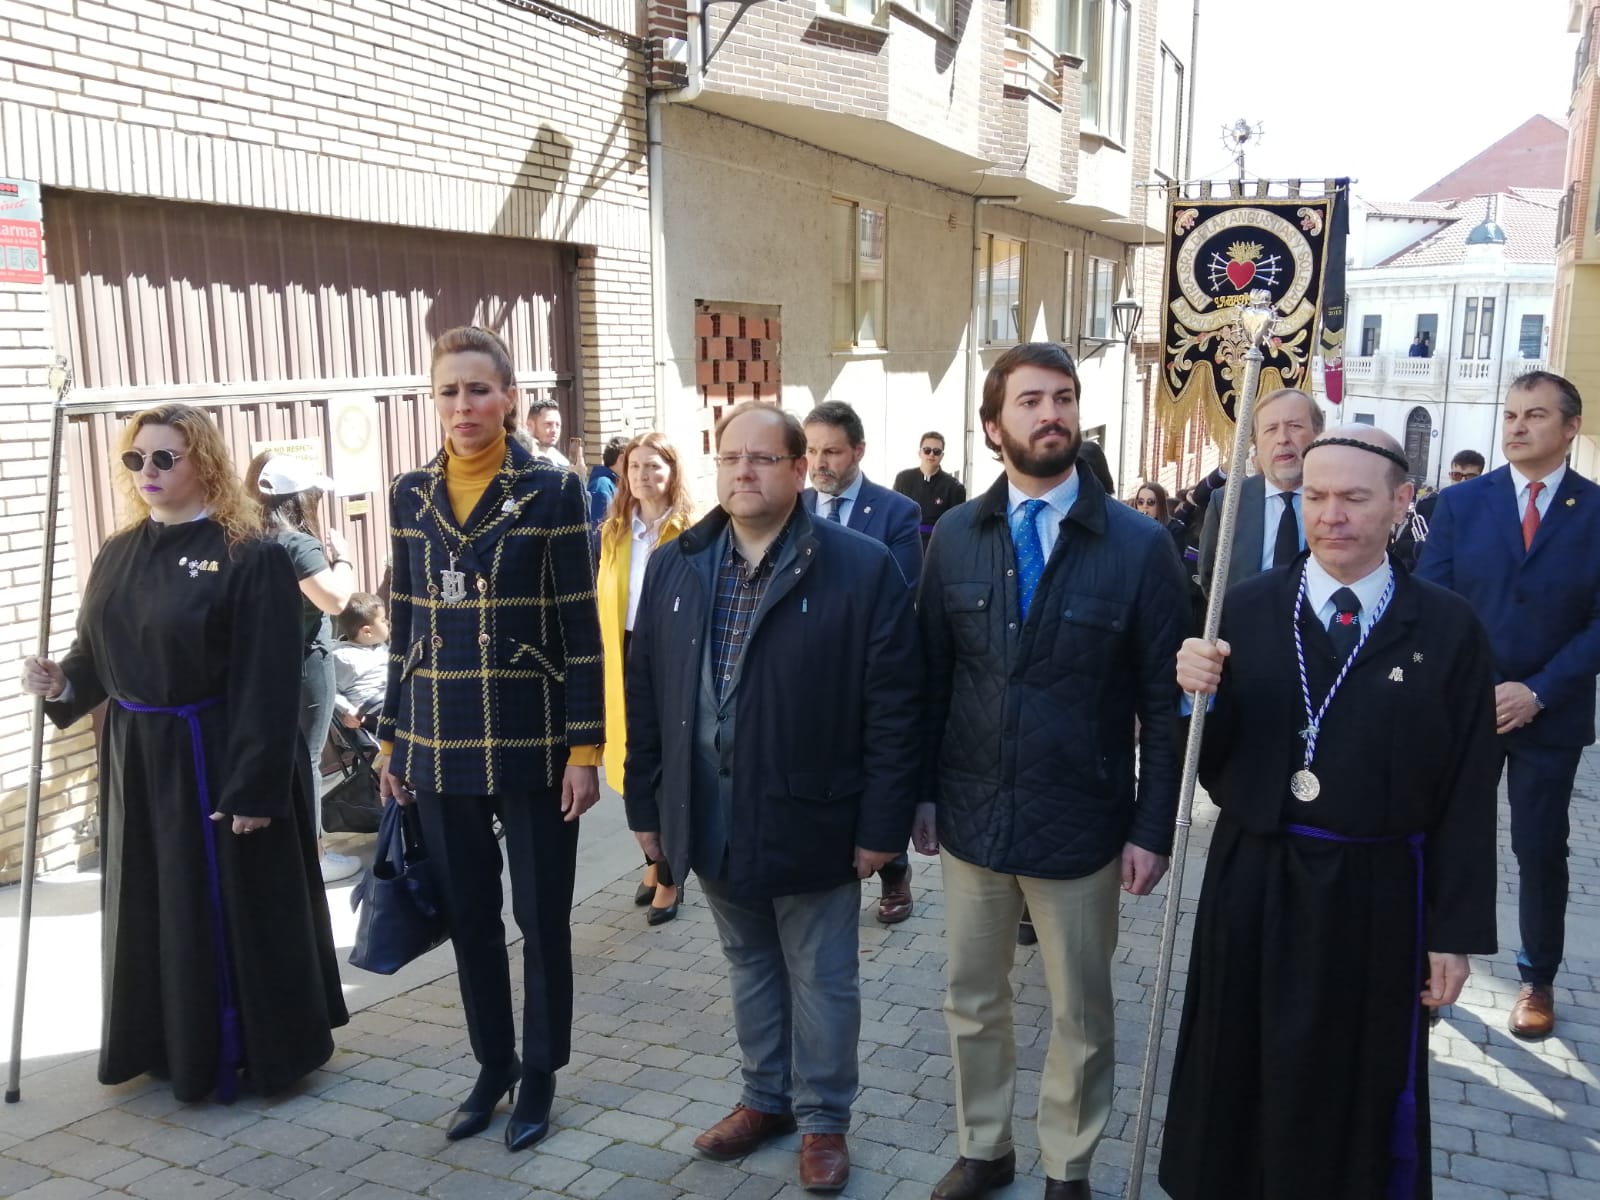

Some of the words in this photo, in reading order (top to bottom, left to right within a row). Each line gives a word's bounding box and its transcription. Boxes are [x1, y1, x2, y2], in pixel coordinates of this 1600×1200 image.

[1229, 211, 1296, 241] ANGUSTIAS
[1292, 238, 1305, 248] Y
[1283, 251, 1311, 309] SOLEDAD
